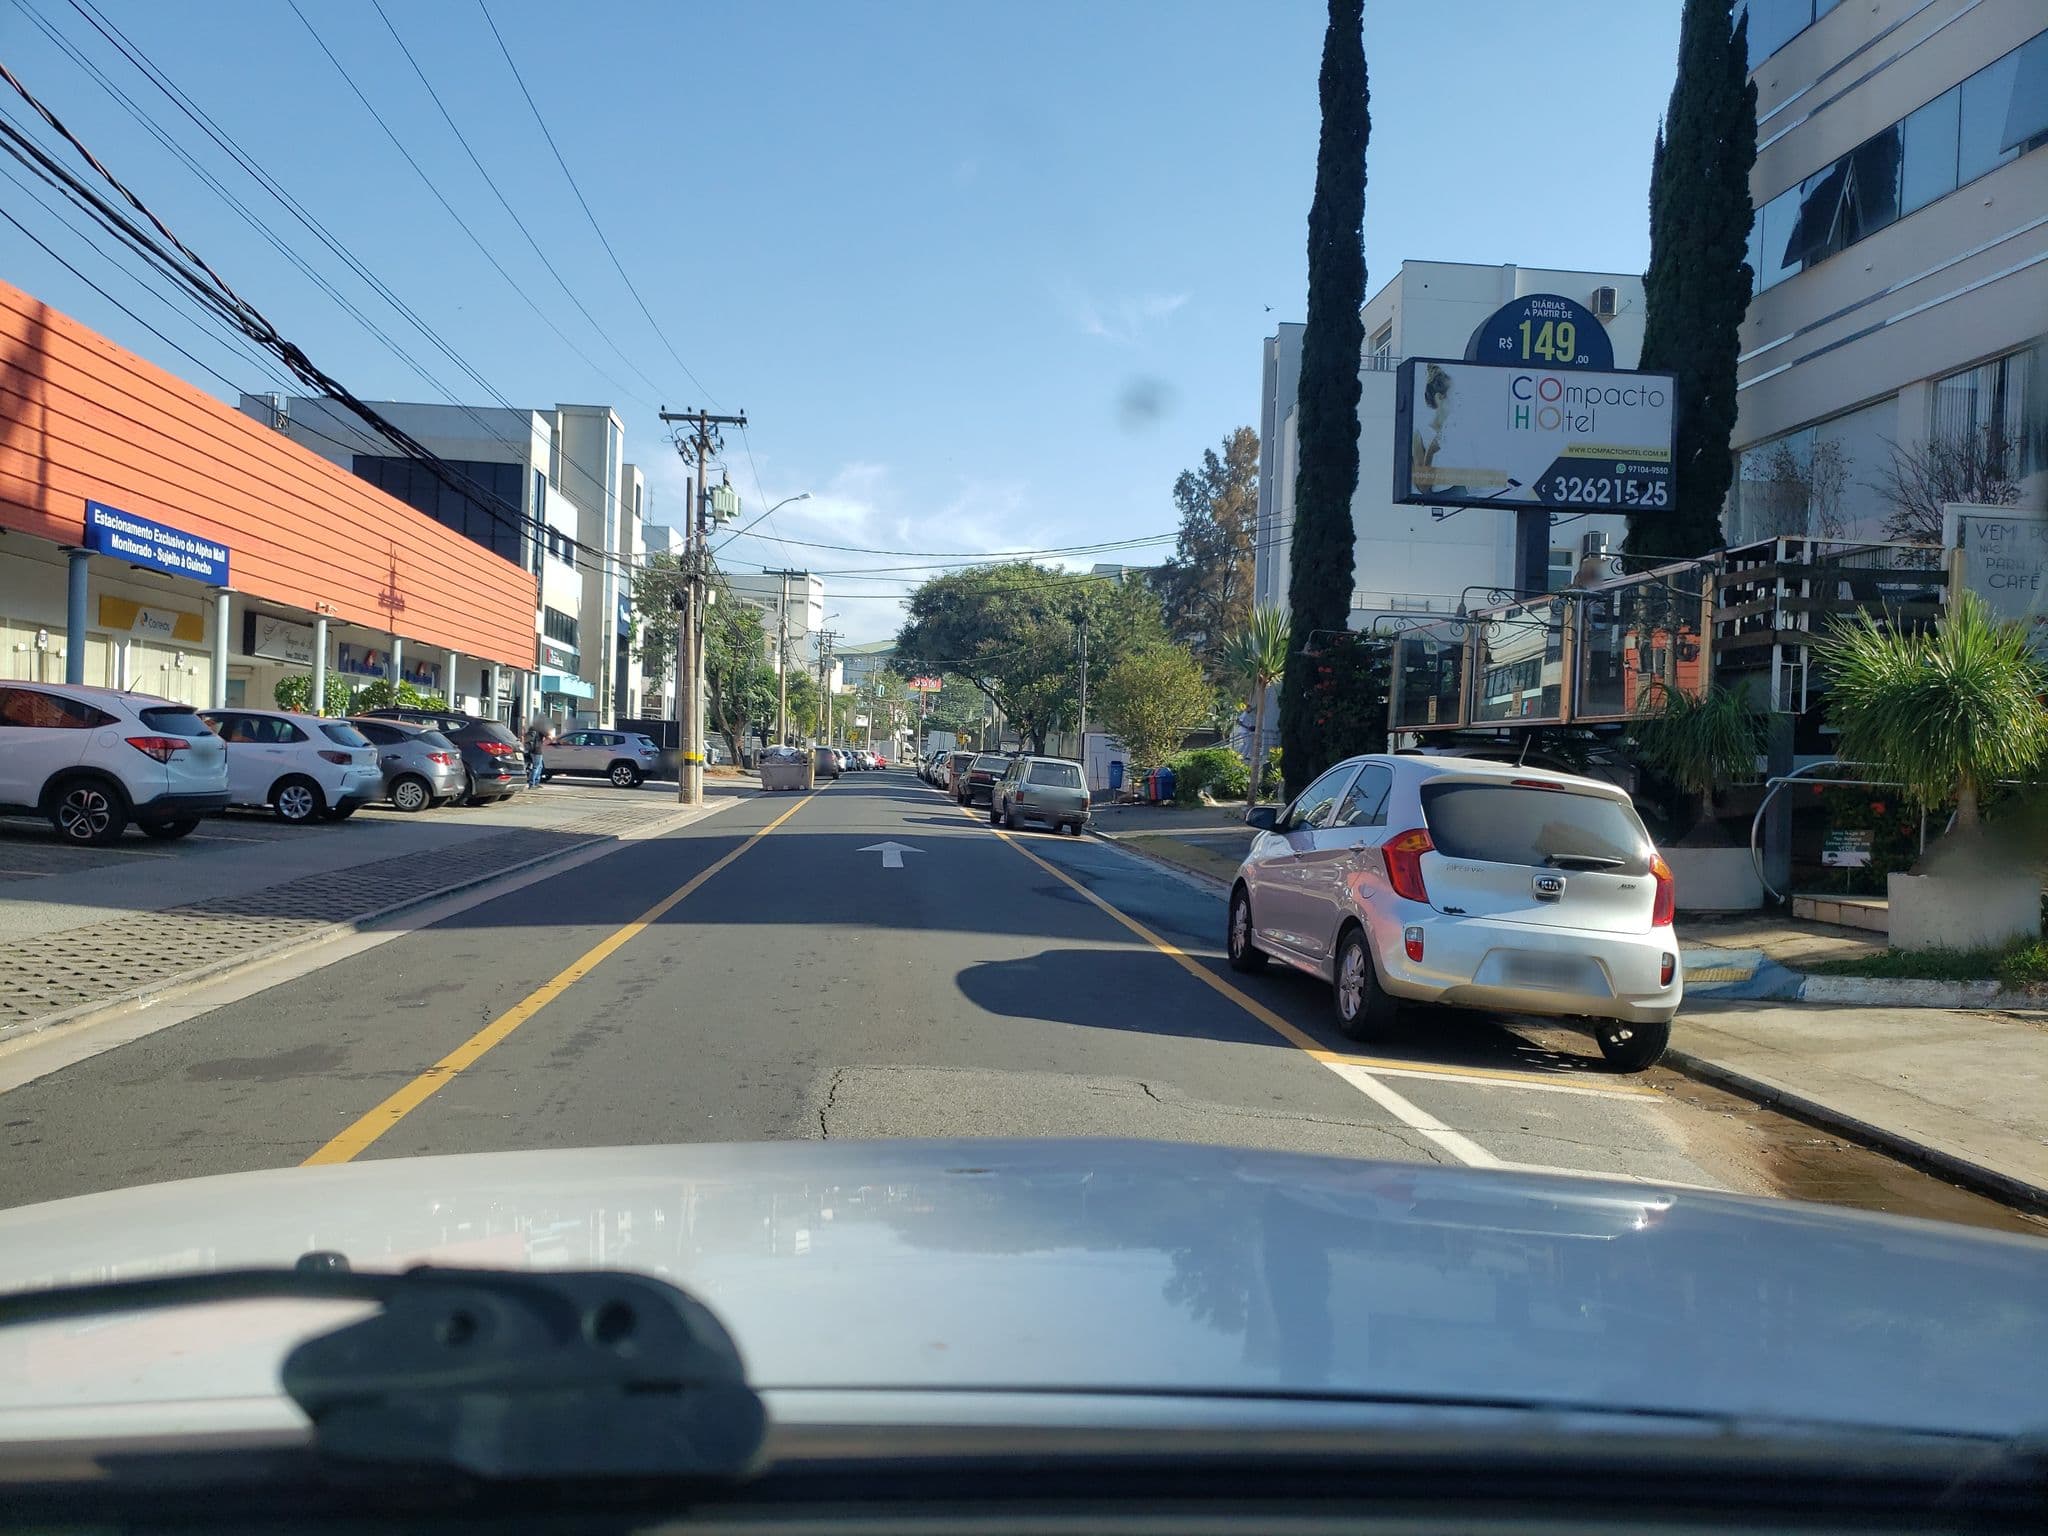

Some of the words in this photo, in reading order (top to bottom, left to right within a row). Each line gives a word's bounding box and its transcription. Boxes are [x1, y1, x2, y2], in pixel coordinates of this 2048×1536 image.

[1524, 308, 1530, 316] A
[1532, 308, 1560, 318] PARTIR
[1561, 310, 1573, 319] DE
[1532, 299, 1566, 310] DIÁRIAS
[1498, 336, 1513, 350] R$
[1519, 320, 1576, 362] 149
[94, 508, 153, 540] Estacionamento
[153, 528, 186, 551] Exclusivo
[186, 539, 195, 554] do
[195, 541, 212, 560] Alpha
[212, 546, 226, 562] Mall
[111, 534, 153, 558] Monitorado
[156, 547, 181, 567] Sujeito
[186, 554, 212, 576] Guincho
[1988, 573, 2041, 591] CAFÉ
[1541, 880, 1559, 890] KIA
